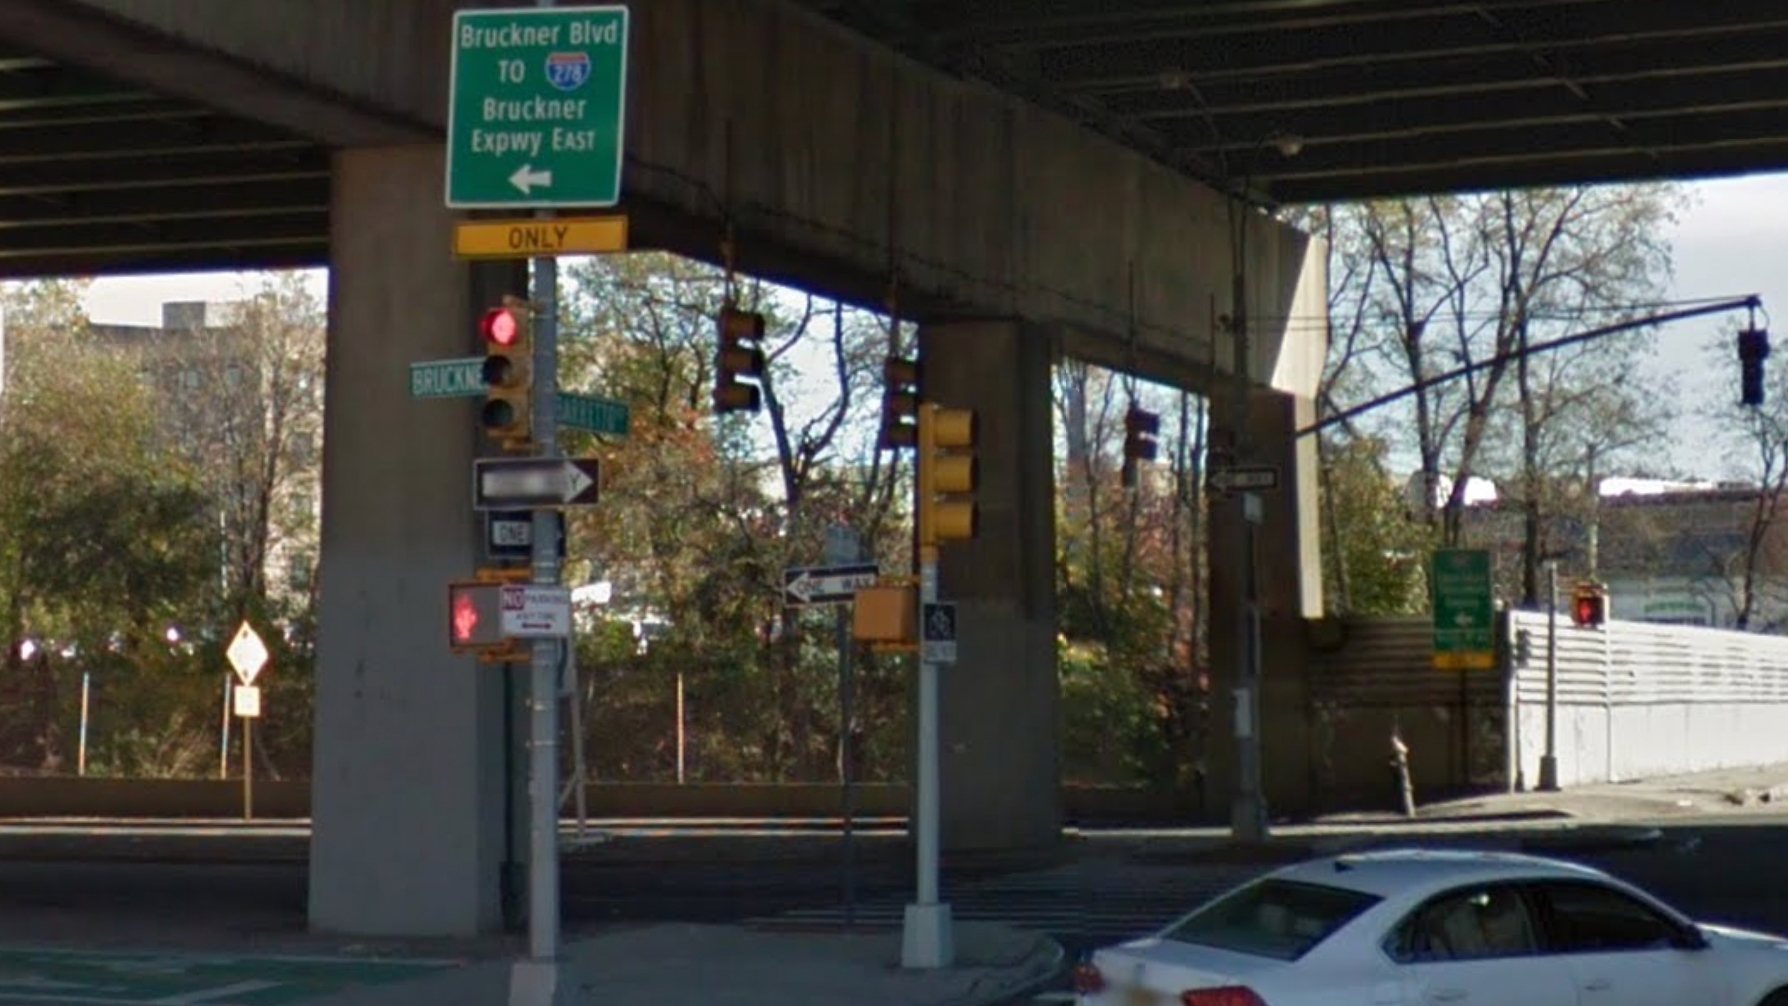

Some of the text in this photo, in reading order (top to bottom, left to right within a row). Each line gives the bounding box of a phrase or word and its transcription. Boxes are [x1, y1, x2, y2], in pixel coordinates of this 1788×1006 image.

[461, 20, 617, 48] Bruckner Blvd
[498, 60, 525, 83] TO
[554, 65, 583, 82] 278
[482, 95, 587, 120] Bruckner
[472, 127, 596, 157] Expwy EAST
[508, 226, 570, 250] ONLY
[498, 522, 526, 544] ONE
[502, 589, 522, 607] NO
